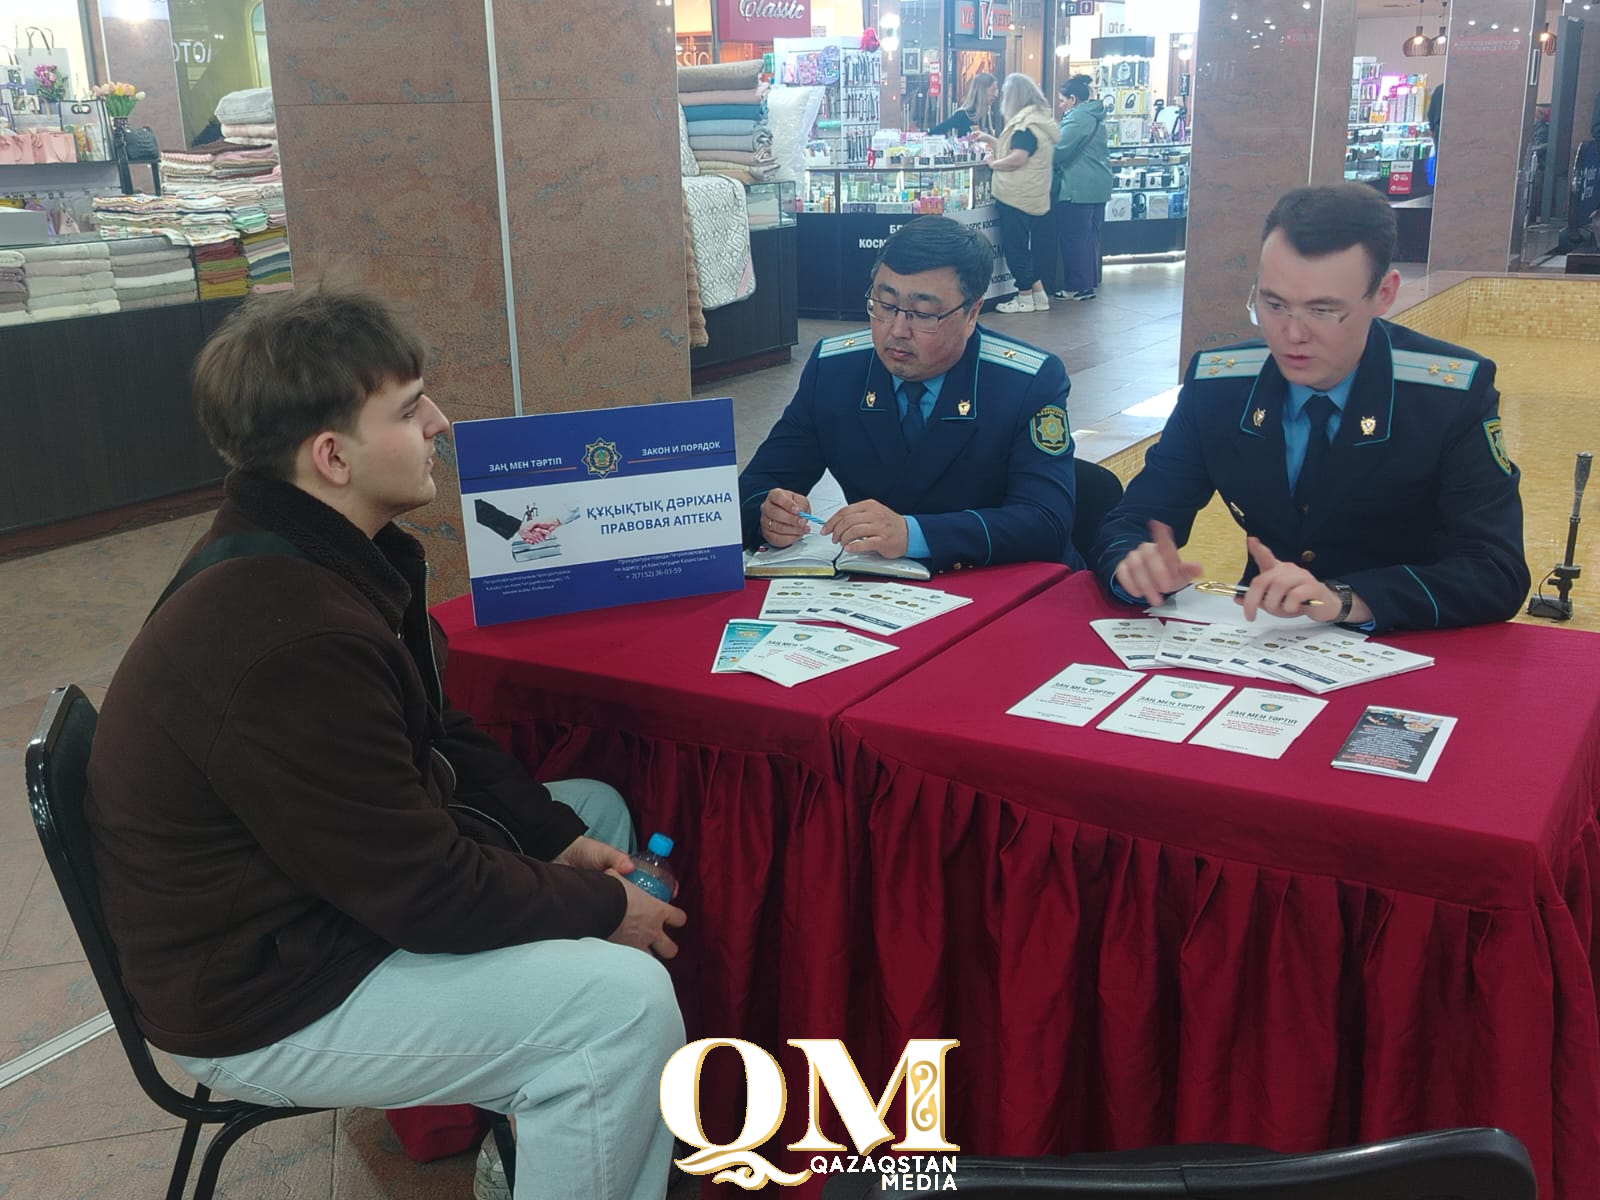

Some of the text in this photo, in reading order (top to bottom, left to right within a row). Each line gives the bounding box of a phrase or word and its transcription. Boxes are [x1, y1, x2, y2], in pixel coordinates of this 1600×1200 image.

[641, 440, 720, 456] ЗАКОН И ПОРЯДОК
[488, 457, 562, 472] ЗАҢ МЕН ТӘРТІП
[586, 492, 732, 520] ҚҰҚЫҚТЫҚ ДӘРІХАНА
[600, 511, 722, 535] ПРАВОВАЯ АПТЕКА
